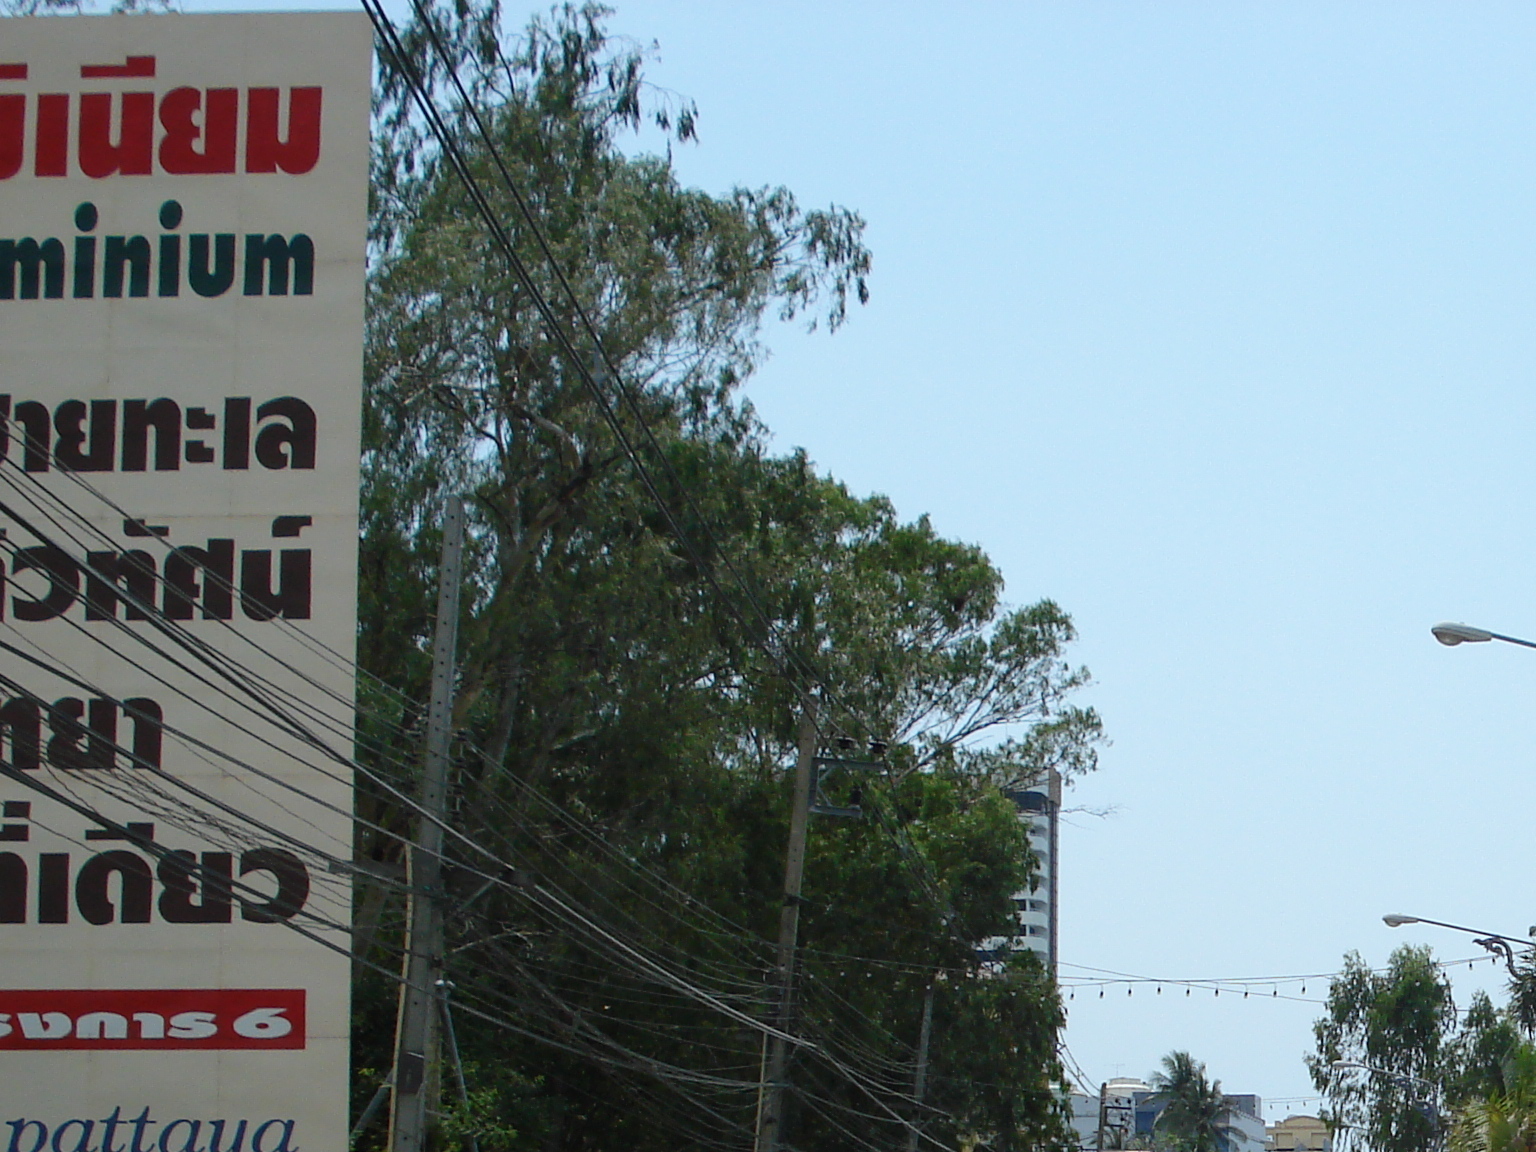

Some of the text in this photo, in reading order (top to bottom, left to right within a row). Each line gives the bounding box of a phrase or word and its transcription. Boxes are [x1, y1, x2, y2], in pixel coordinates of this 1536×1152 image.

[0, 199, 315, 300] minium
[0, 394, 317, 473] ายทะเล
[0, 514, 312, 623] วทัศน์
[0, 1007, 293, 1040] งการ 6
